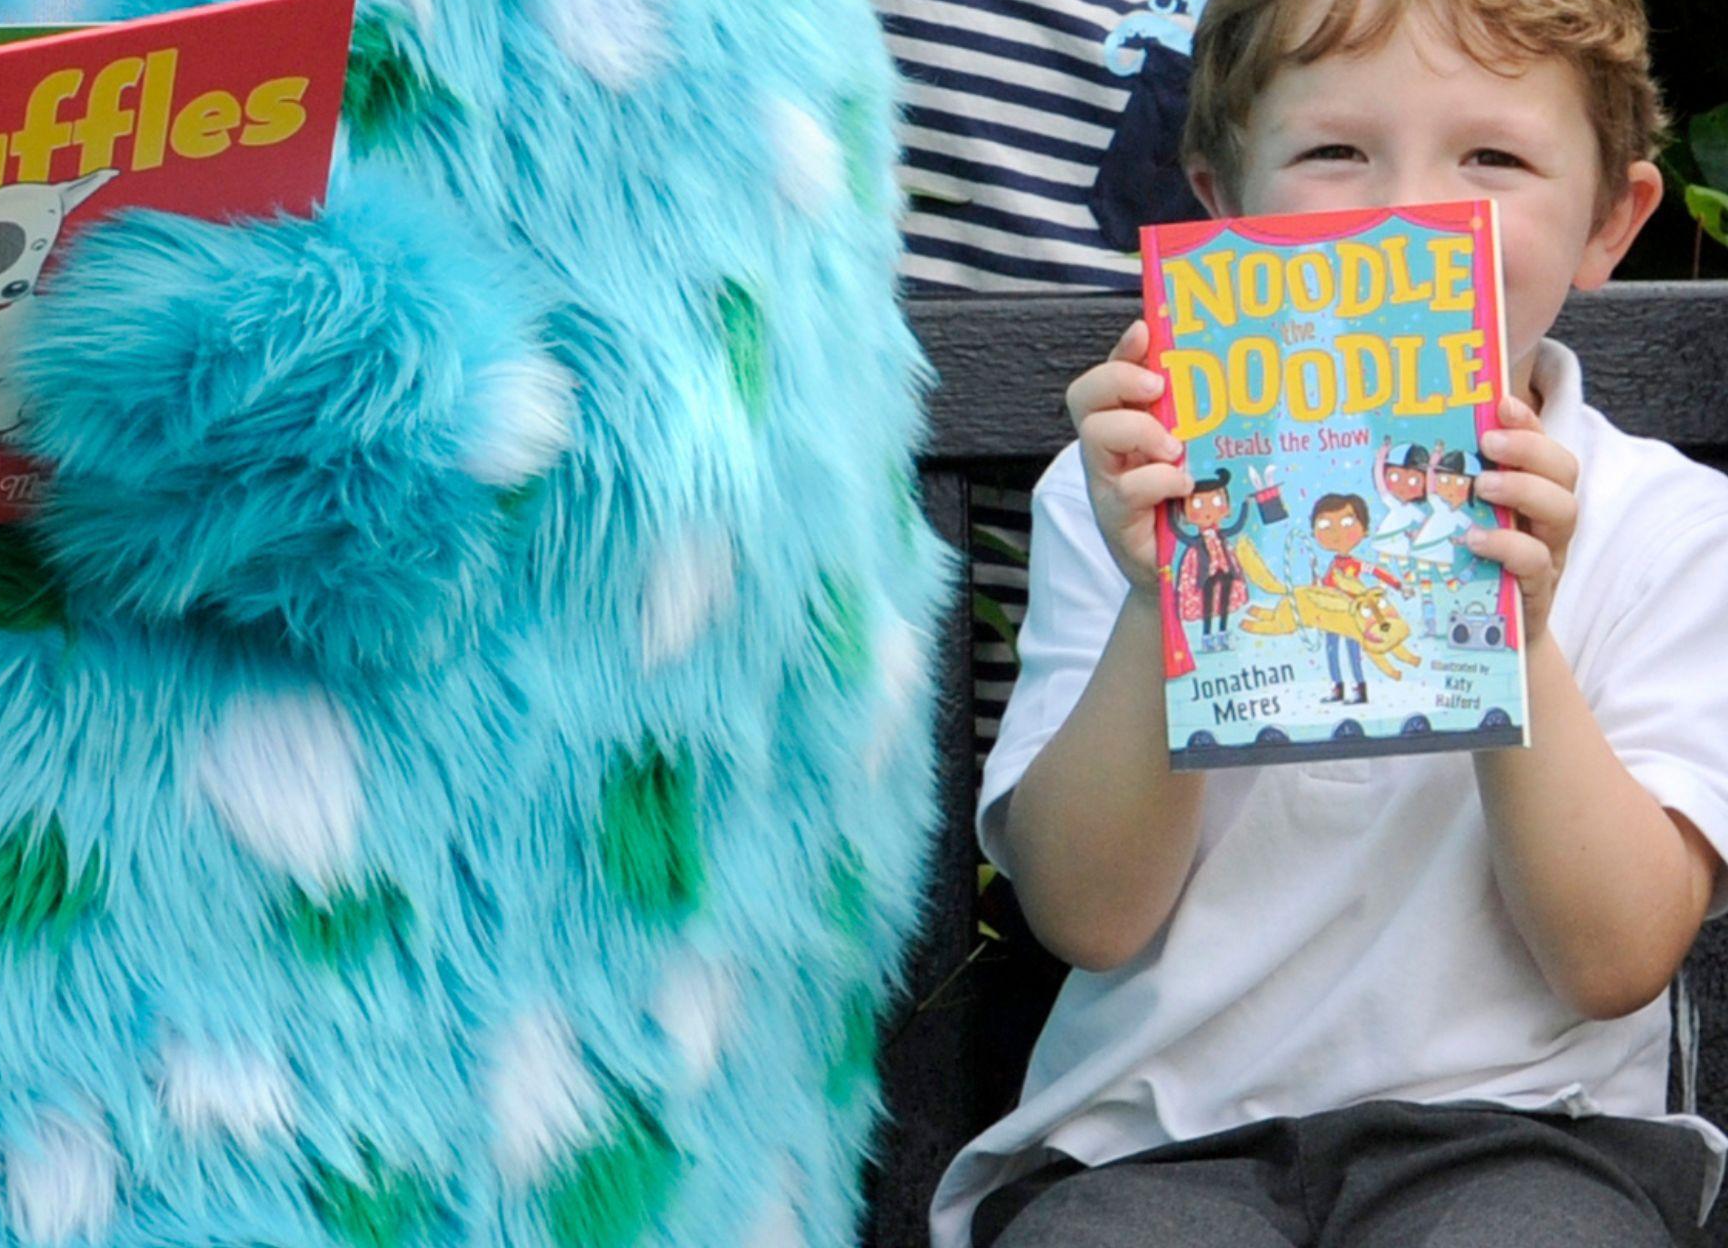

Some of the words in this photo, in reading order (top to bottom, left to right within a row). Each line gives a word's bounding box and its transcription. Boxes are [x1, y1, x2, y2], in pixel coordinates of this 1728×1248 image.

[1162, 235, 1476, 336] NOODLE
[1281, 319, 1316, 346] the
[1159, 330, 1493, 440] DOODLE
[1214, 432, 1273, 460] Steals
[1280, 431, 1311, 453] the
[1317, 428, 1370, 451] Show
[1191, 661, 1296, 702] Jonathan
[1445, 676, 1473, 692] Katy
[1213, 698, 1282, 726] Meres
[1435, 694, 1481, 710] Halford
